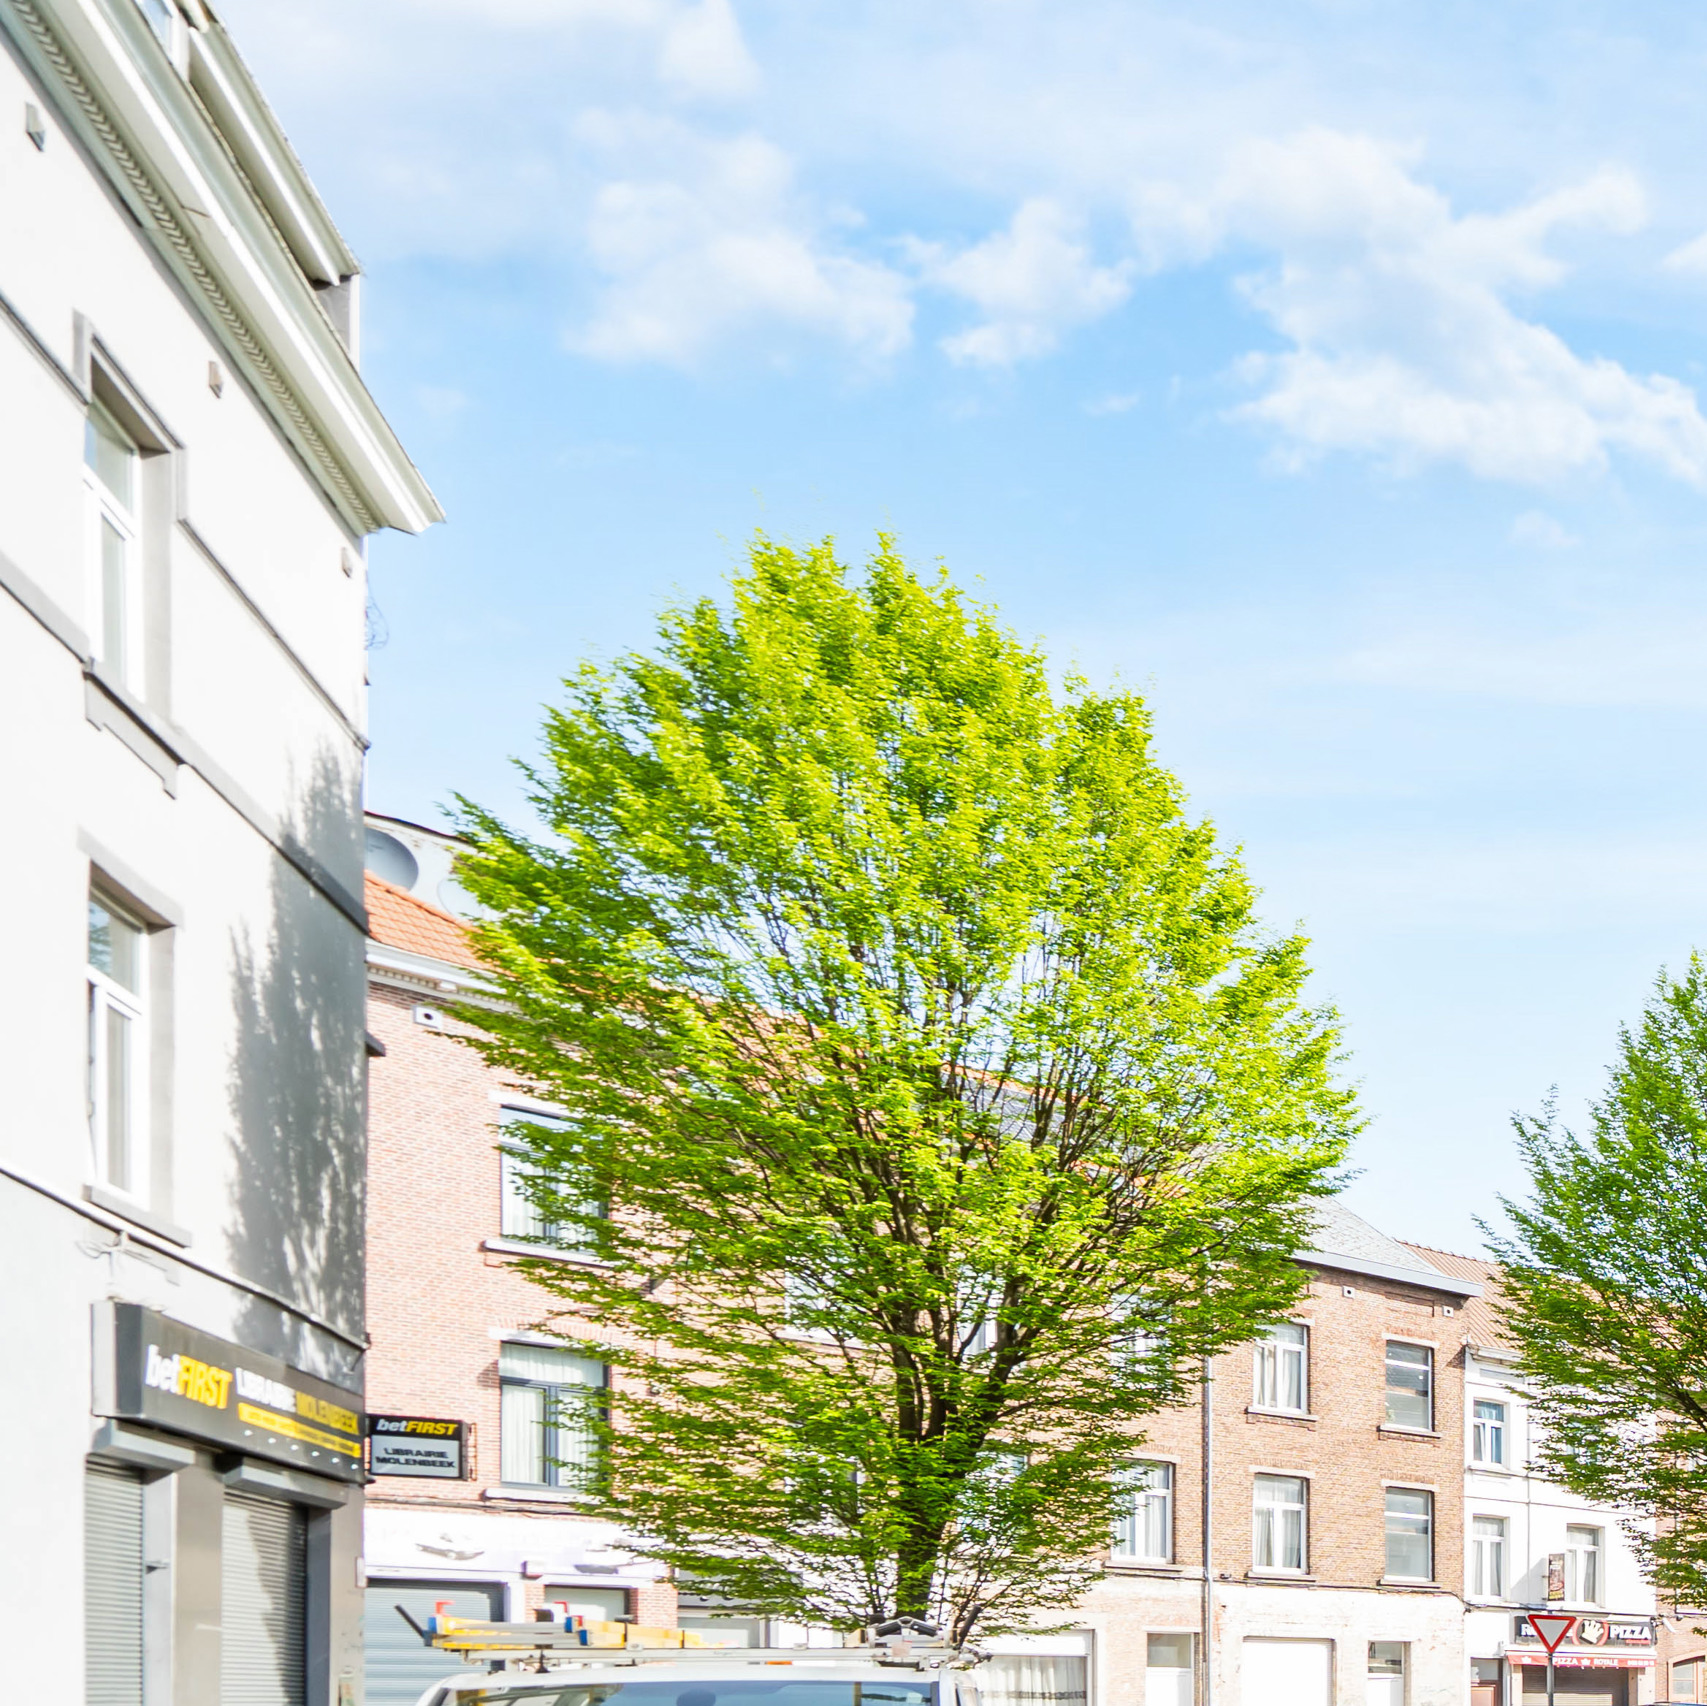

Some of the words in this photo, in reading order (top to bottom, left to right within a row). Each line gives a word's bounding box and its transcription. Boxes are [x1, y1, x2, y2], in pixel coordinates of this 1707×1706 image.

[145, 1344, 233, 1410] betFIRST
[376, 1418, 459, 1436] betFIRST
[383, 1447, 449, 1459] LIBRAIRIE
[375, 1456, 456, 1468] MOLENBEEK
[1609, 1625, 1652, 1640] PIZZA
[1552, 1657, 1578, 1666] PIZZA
[1593, 1658, 1619, 1666] ROYALE
